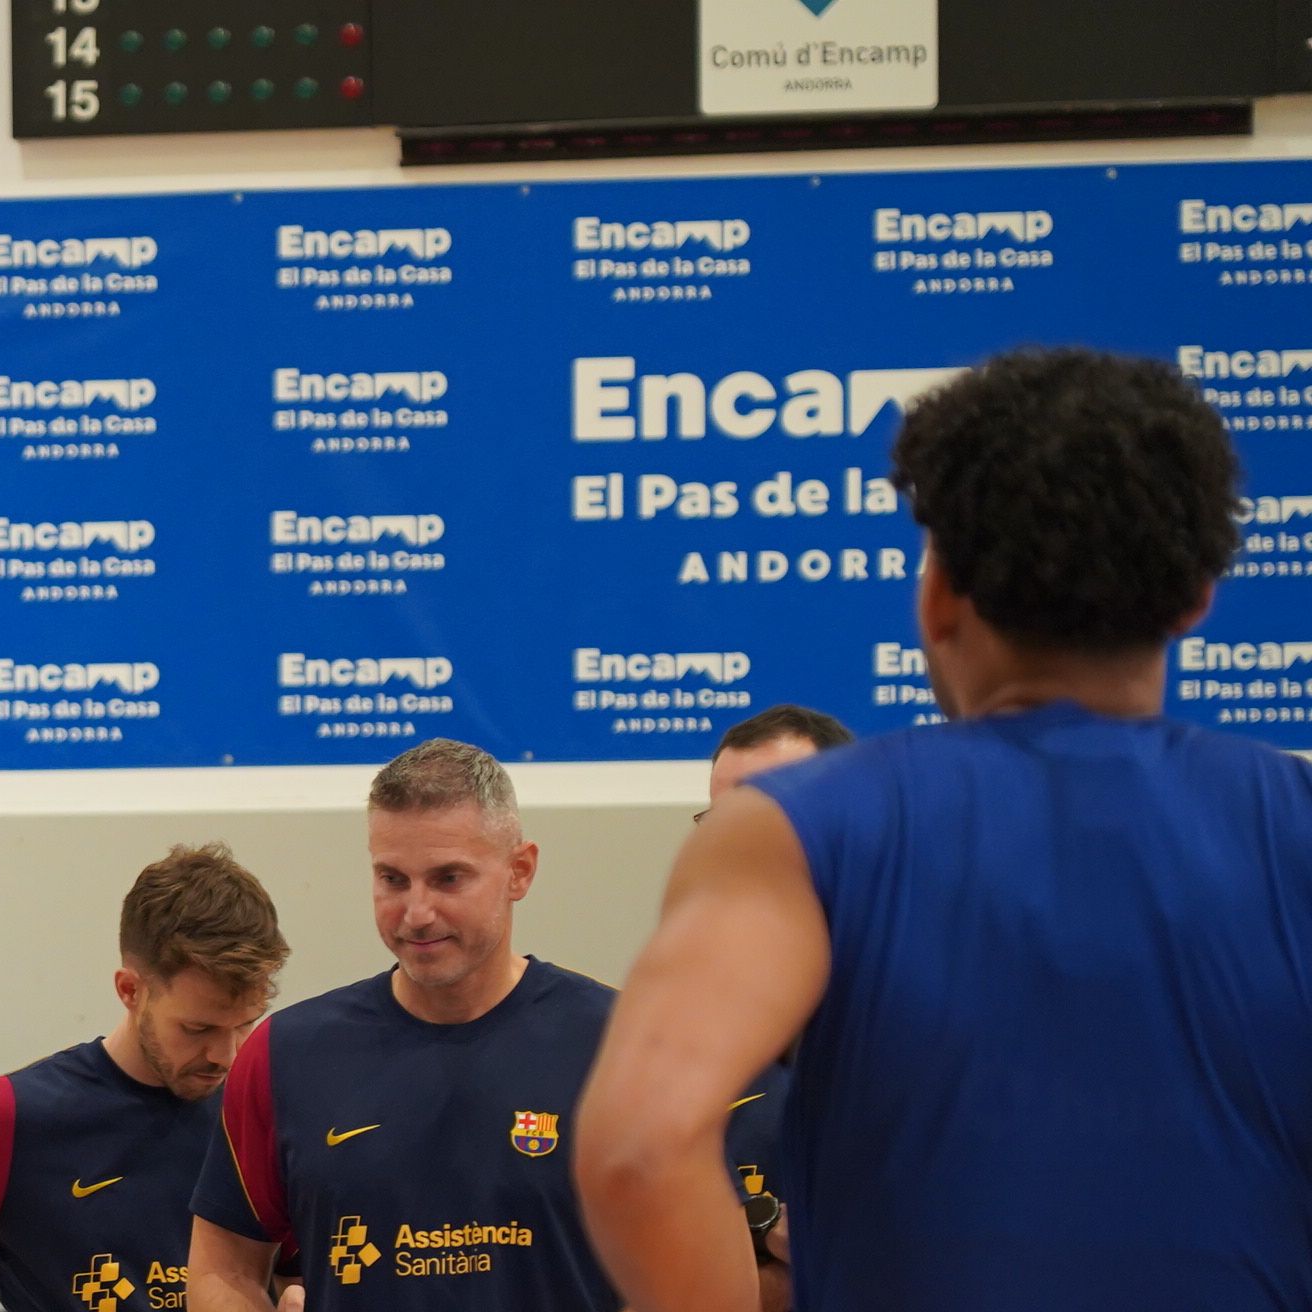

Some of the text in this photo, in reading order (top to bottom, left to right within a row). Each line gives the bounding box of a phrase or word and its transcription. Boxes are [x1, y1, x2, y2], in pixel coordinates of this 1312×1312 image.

[45, 26, 100, 68] 14
[45, 79, 100, 121] 15
[574, 217, 750, 251] Encamp
[875, 208, 1053, 242] Encamp
[277, 225, 451, 259] Encamp
[574, 256, 750, 279] El Pas de la Casa
[875, 248, 1053, 271] El Pas de la Casa
[9, 276, 48, 295] Pas
[49, 275, 79, 294] de
[80, 274, 103, 292] la
[104, 273, 158, 292] Casa
[278, 265, 452, 287] El Pas de la Casa
[914, 277, 1013, 293] ANDORRA
[316, 293, 413, 309] ANDORRA
[614, 285, 711, 301] ANDORRA
[24, 302, 120, 318] ANDORRA
[274, 368, 448, 403] Encamp
[572, 356, 974, 442] Encam
[8, 418, 47, 436] Pas
[48, 417, 78, 435] de
[80, 415, 102, 435] la
[103, 415, 156, 434] Casa
[274, 408, 448, 430] El Pas de la Casa
[23, 443, 119, 459] ANDORRA
[313, 437, 410, 452] ANDORRA
[572, 467, 898, 520] El Pas de la
[271, 511, 444, 546] Encamp
[7, 559, 46, 578] Pas
[47, 558, 77, 577] de
[79, 557, 101, 576] la
[102, 557, 155, 576] Casa
[271, 551, 445, 573] El Pas de la Casa
[678, 546, 928, 584] ANDORR
[22, 585, 118, 601] ANDORRA
[310, 579, 407, 595] ANDORRA
[279, 653, 453, 688] Encamp
[574, 648, 750, 683] Encamp
[11, 700, 50, 719] Pas
[52, 700, 81, 719] de
[83, 699, 105, 718] la
[106, 699, 160, 717] Casa
[280, 693, 453, 715] El Pas de la Casa
[575, 688, 750, 710] El Pas de la Casa
[26, 727, 122, 742] ANDORRA
[318, 722, 415, 737] ANDORRA
[614, 717, 712, 732] ANDORRA
[395, 1220, 532, 1249] Assistència
